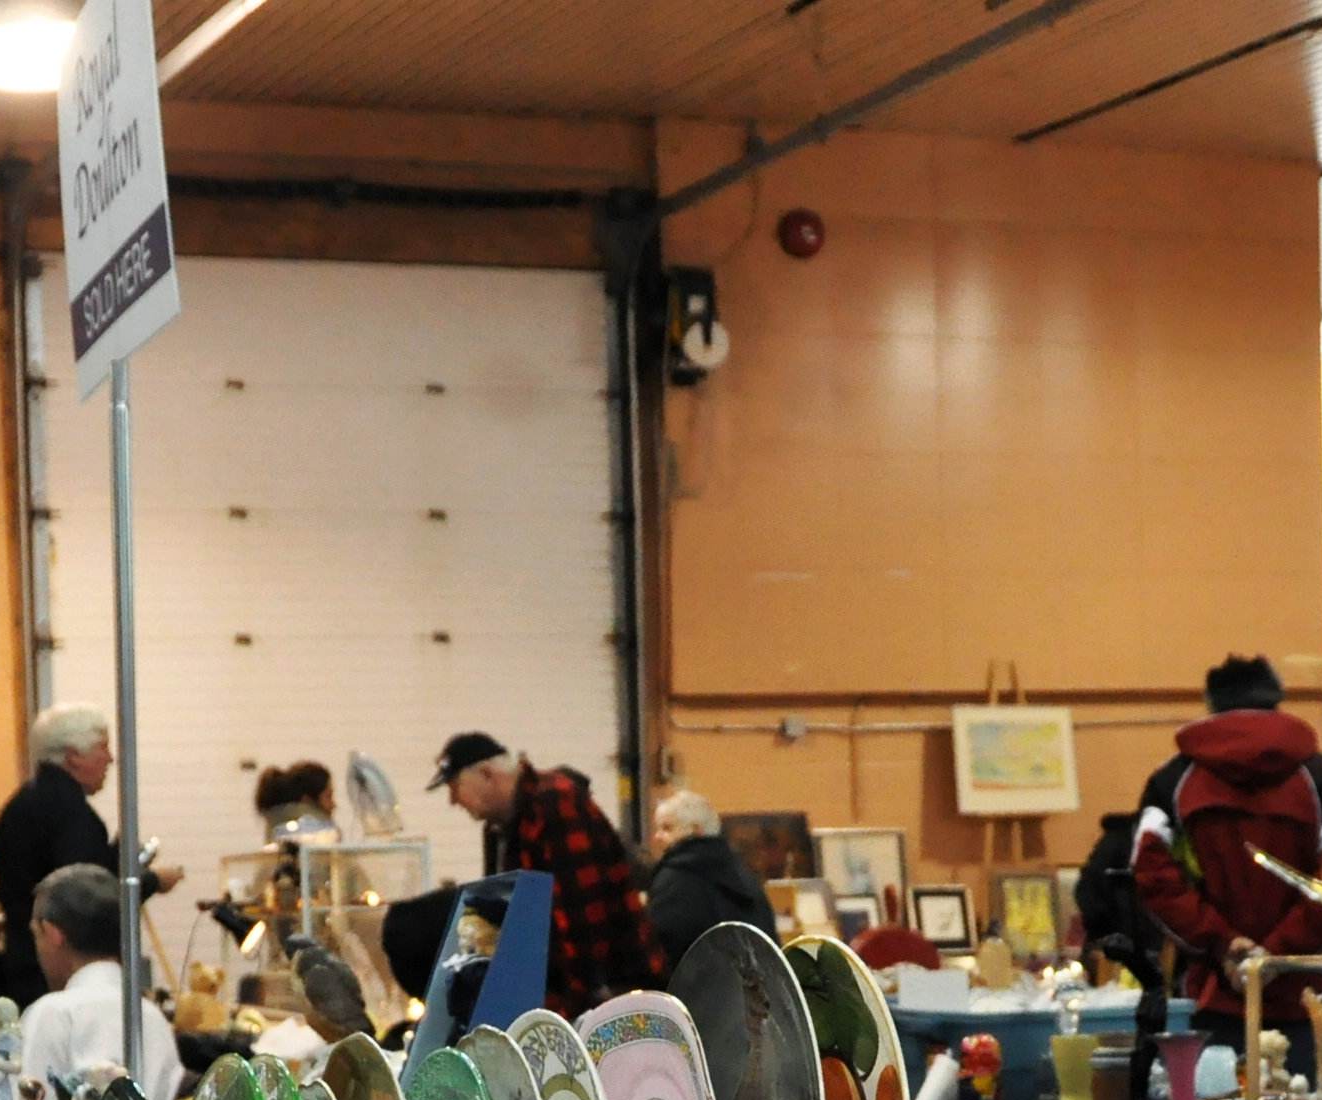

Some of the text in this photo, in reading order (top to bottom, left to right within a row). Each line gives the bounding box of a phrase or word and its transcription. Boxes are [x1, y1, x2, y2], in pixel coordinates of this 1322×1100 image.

[73, 1, 120, 147] Royal
[73, 108, 142, 239] Doulton
[82, 230, 154, 340] SOLD HERE
